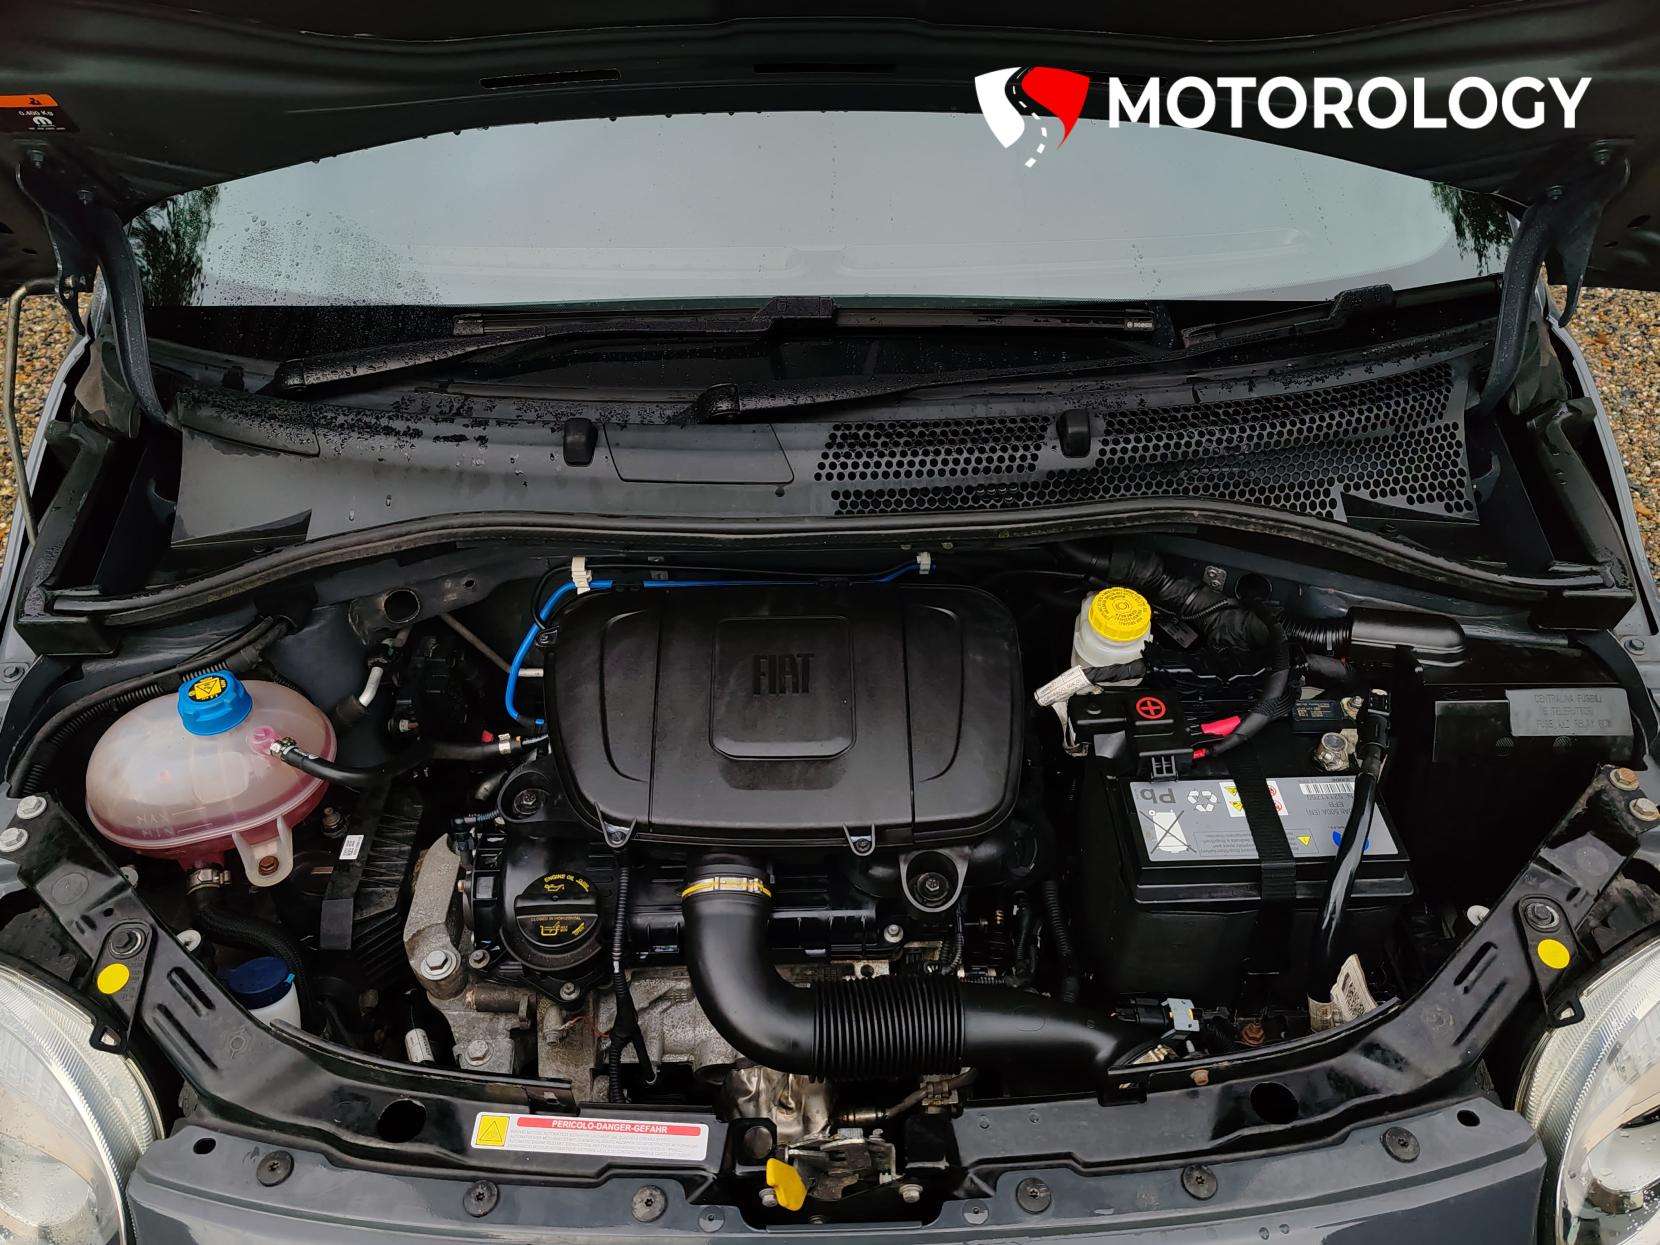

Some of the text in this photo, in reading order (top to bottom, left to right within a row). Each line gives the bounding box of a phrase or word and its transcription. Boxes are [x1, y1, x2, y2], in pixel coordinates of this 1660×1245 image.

[753, 652, 814, 695] FIAT
[1140, 788, 1176, 804] Pb
[544, 874, 565, 882] ENGINE
[552, 1120, 668, 1134] PERICOLO-DANGER-GEFAHR
